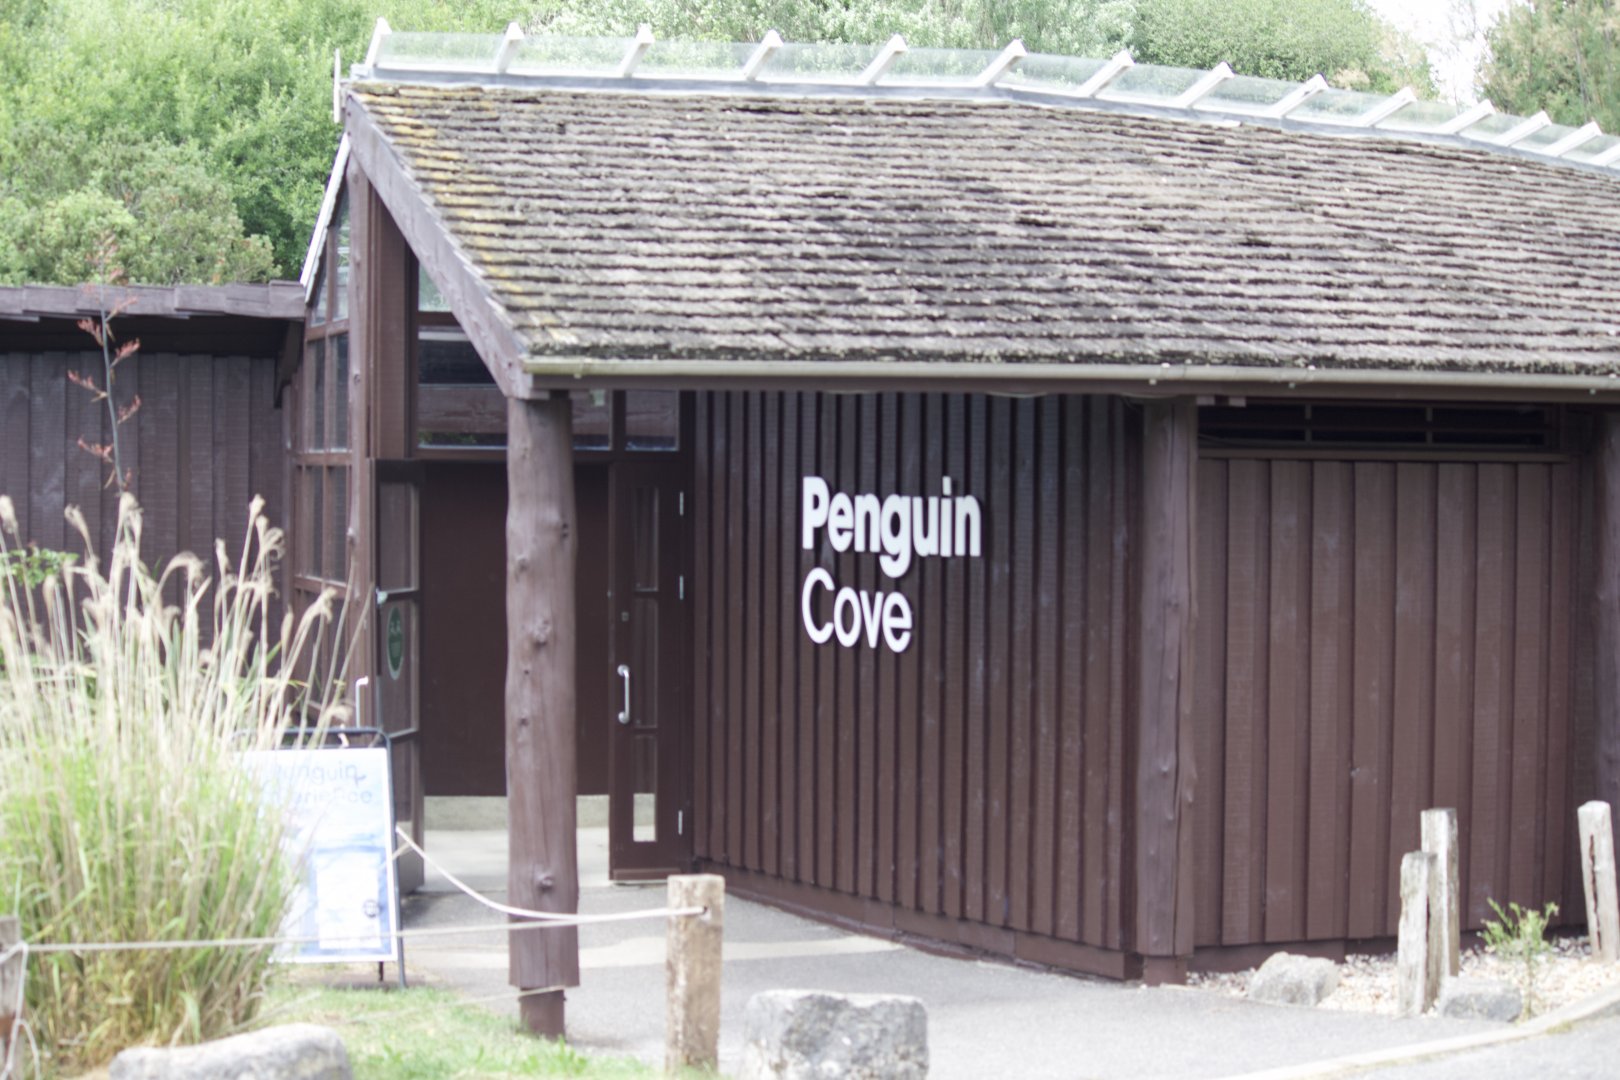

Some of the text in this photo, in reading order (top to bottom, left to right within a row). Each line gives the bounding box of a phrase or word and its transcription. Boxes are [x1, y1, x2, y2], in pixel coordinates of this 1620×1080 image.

[802, 476, 981, 578] Penguin
[802, 567, 912, 652] Cove
[274, 760, 367, 787] nguin
